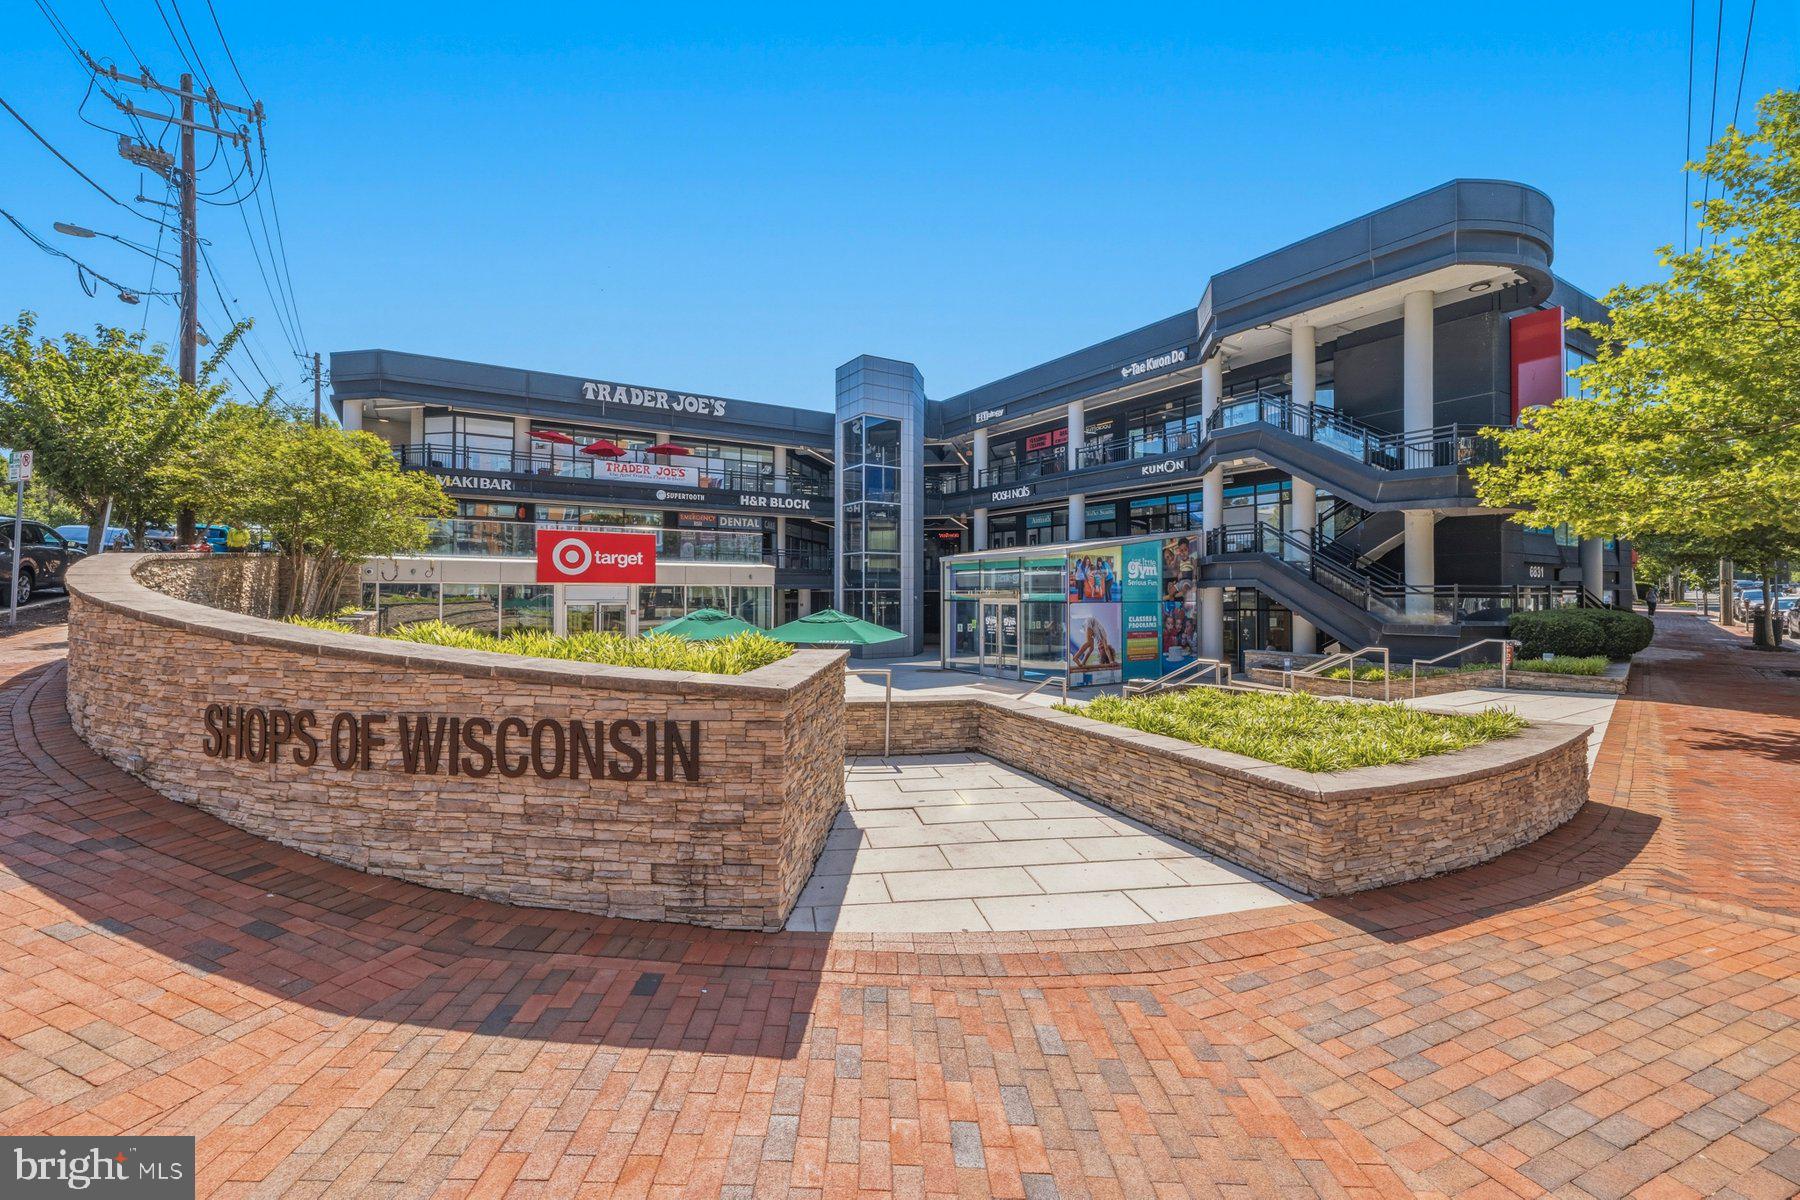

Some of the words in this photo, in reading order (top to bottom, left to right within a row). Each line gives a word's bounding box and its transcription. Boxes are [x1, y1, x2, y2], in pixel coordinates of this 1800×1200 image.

[1130, 362, 1146, 375] Tae
[1146, 355, 1171, 371] Kwon
[1172, 350, 1186, 364] Do
[582, 382, 669, 409] TRADER
[672, 395, 726, 416] JOE'S
[606, 462, 651, 475] TRADER
[656, 466, 686, 477] JOE'S
[1141, 460, 1185, 475] KUMON
[666, 492, 705, 501] SUPERTOOTH
[740, 495, 767, 507] H&R
[769, 498, 810, 510] BLOCK
[992, 490, 1011, 501] POSH
[719, 517, 760, 528] DENTAL
[594, 550, 643, 568] target
[1127, 561, 1158, 579] gym
[1128, 615, 1151, 623] CLASSES
[203, 703, 317, 767] SHOPS
[330, 712, 387, 771] OF
[398, 715, 699, 782] WISCONSIN
